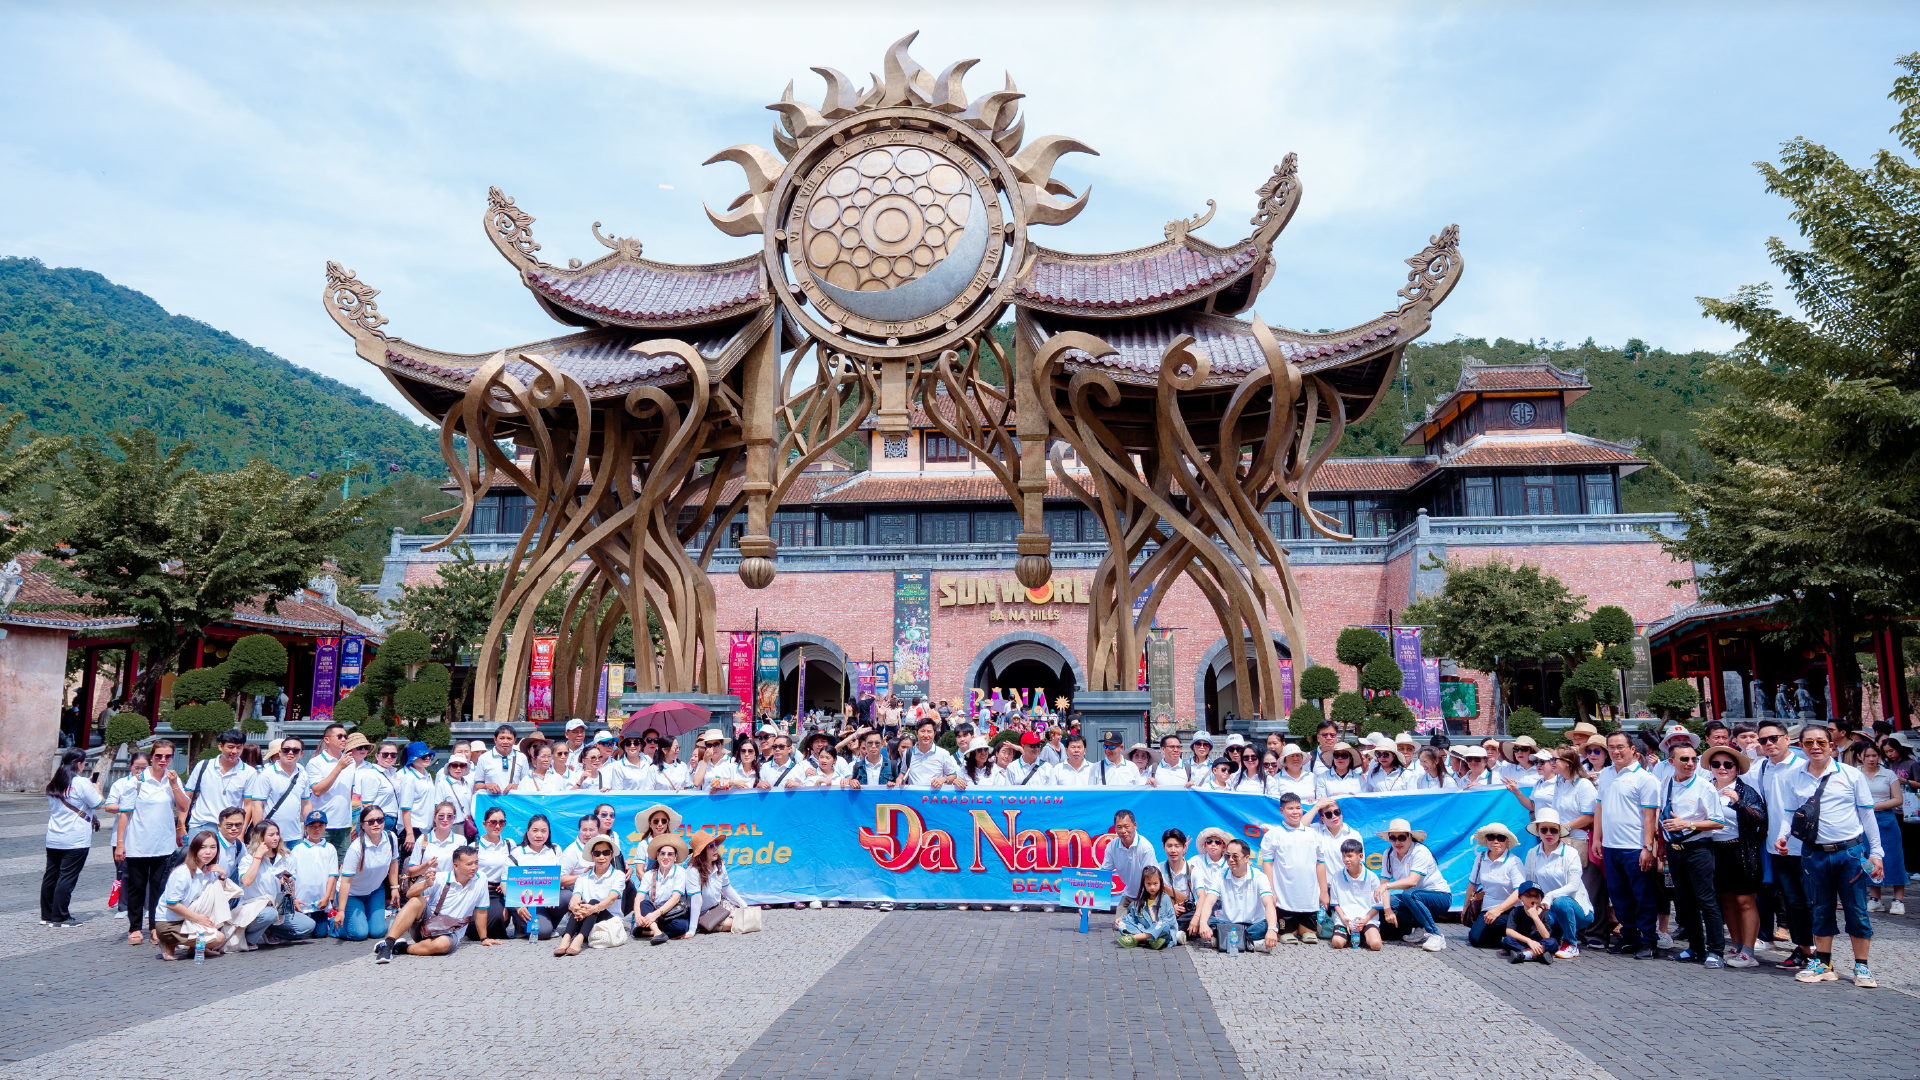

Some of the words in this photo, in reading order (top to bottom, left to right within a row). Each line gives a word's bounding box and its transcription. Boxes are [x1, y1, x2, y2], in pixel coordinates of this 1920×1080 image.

[888, 132, 906, 143] XII
[939, 576, 997, 607] SUN
[1000, 573, 1094, 605] WORL
[989, 610, 1005, 621] BA
[1009, 610, 1026, 621] NA
[1030, 609, 1060, 621] HILLS
[921, 795, 993, 805] PARADIES
[1000, 795, 1064, 805] TOURISM
[673, 822, 763, 837] GLOBAL
[858, 802, 960, 873] Da
[520, 889, 545, 905] 04
[1074, 889, 1095, 907] 01
